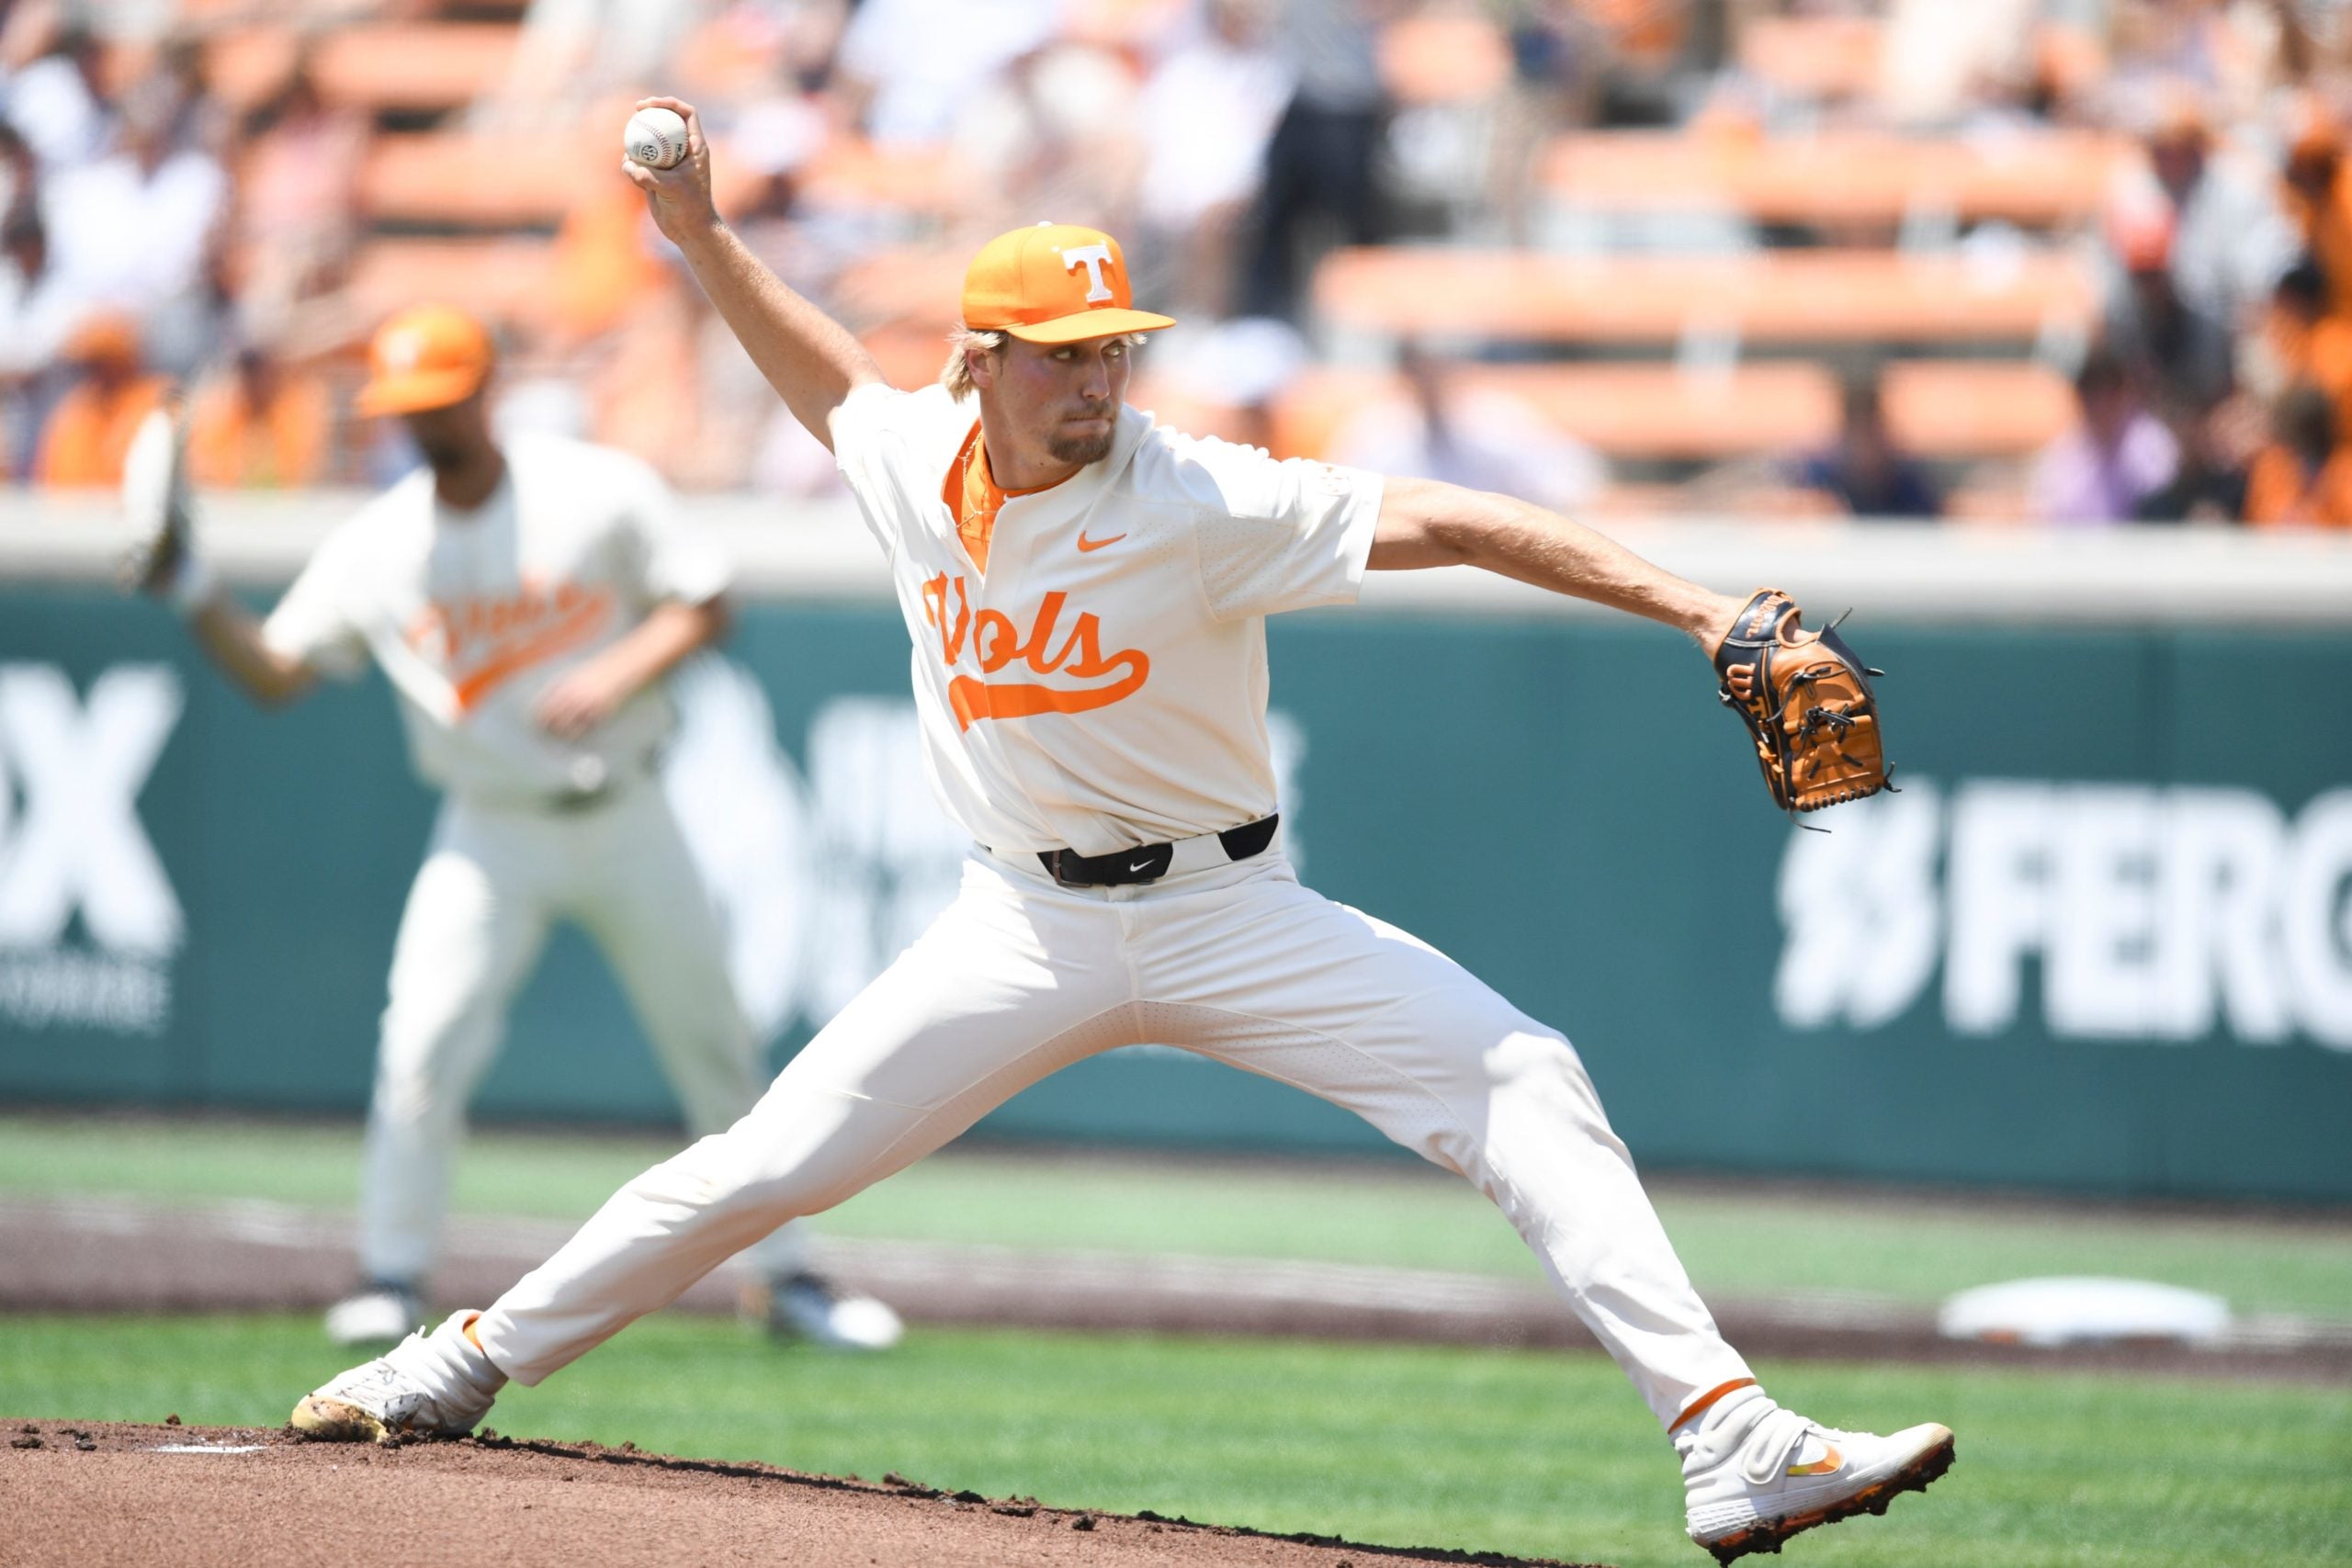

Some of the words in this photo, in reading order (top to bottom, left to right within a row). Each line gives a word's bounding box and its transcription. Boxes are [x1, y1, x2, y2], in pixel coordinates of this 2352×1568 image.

[1061, 243, 1114, 304] T
[922, 570, 1149, 732] Vols
[0, 663, 187, 953] X
